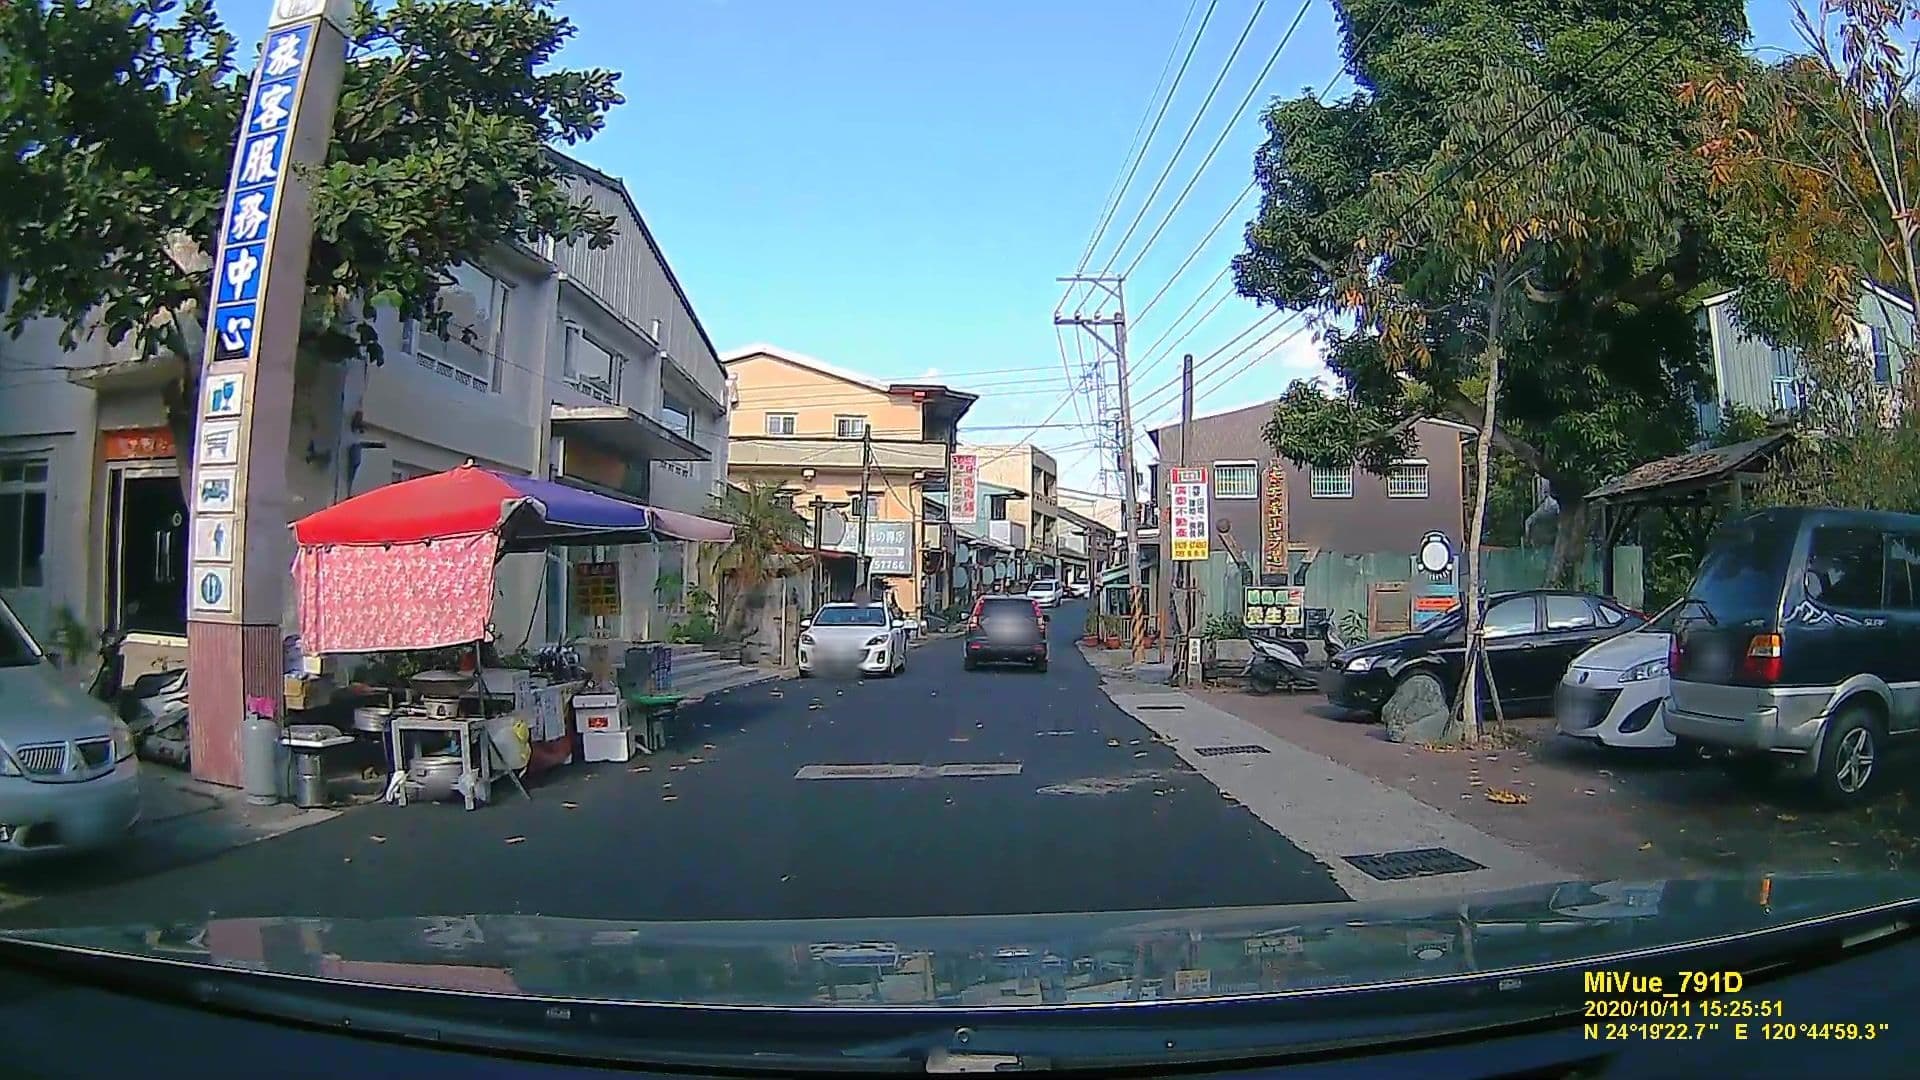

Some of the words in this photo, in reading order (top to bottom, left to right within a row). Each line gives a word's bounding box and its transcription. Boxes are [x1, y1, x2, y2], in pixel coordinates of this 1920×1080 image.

[222, 34, 302, 351] 旅客服務中心
